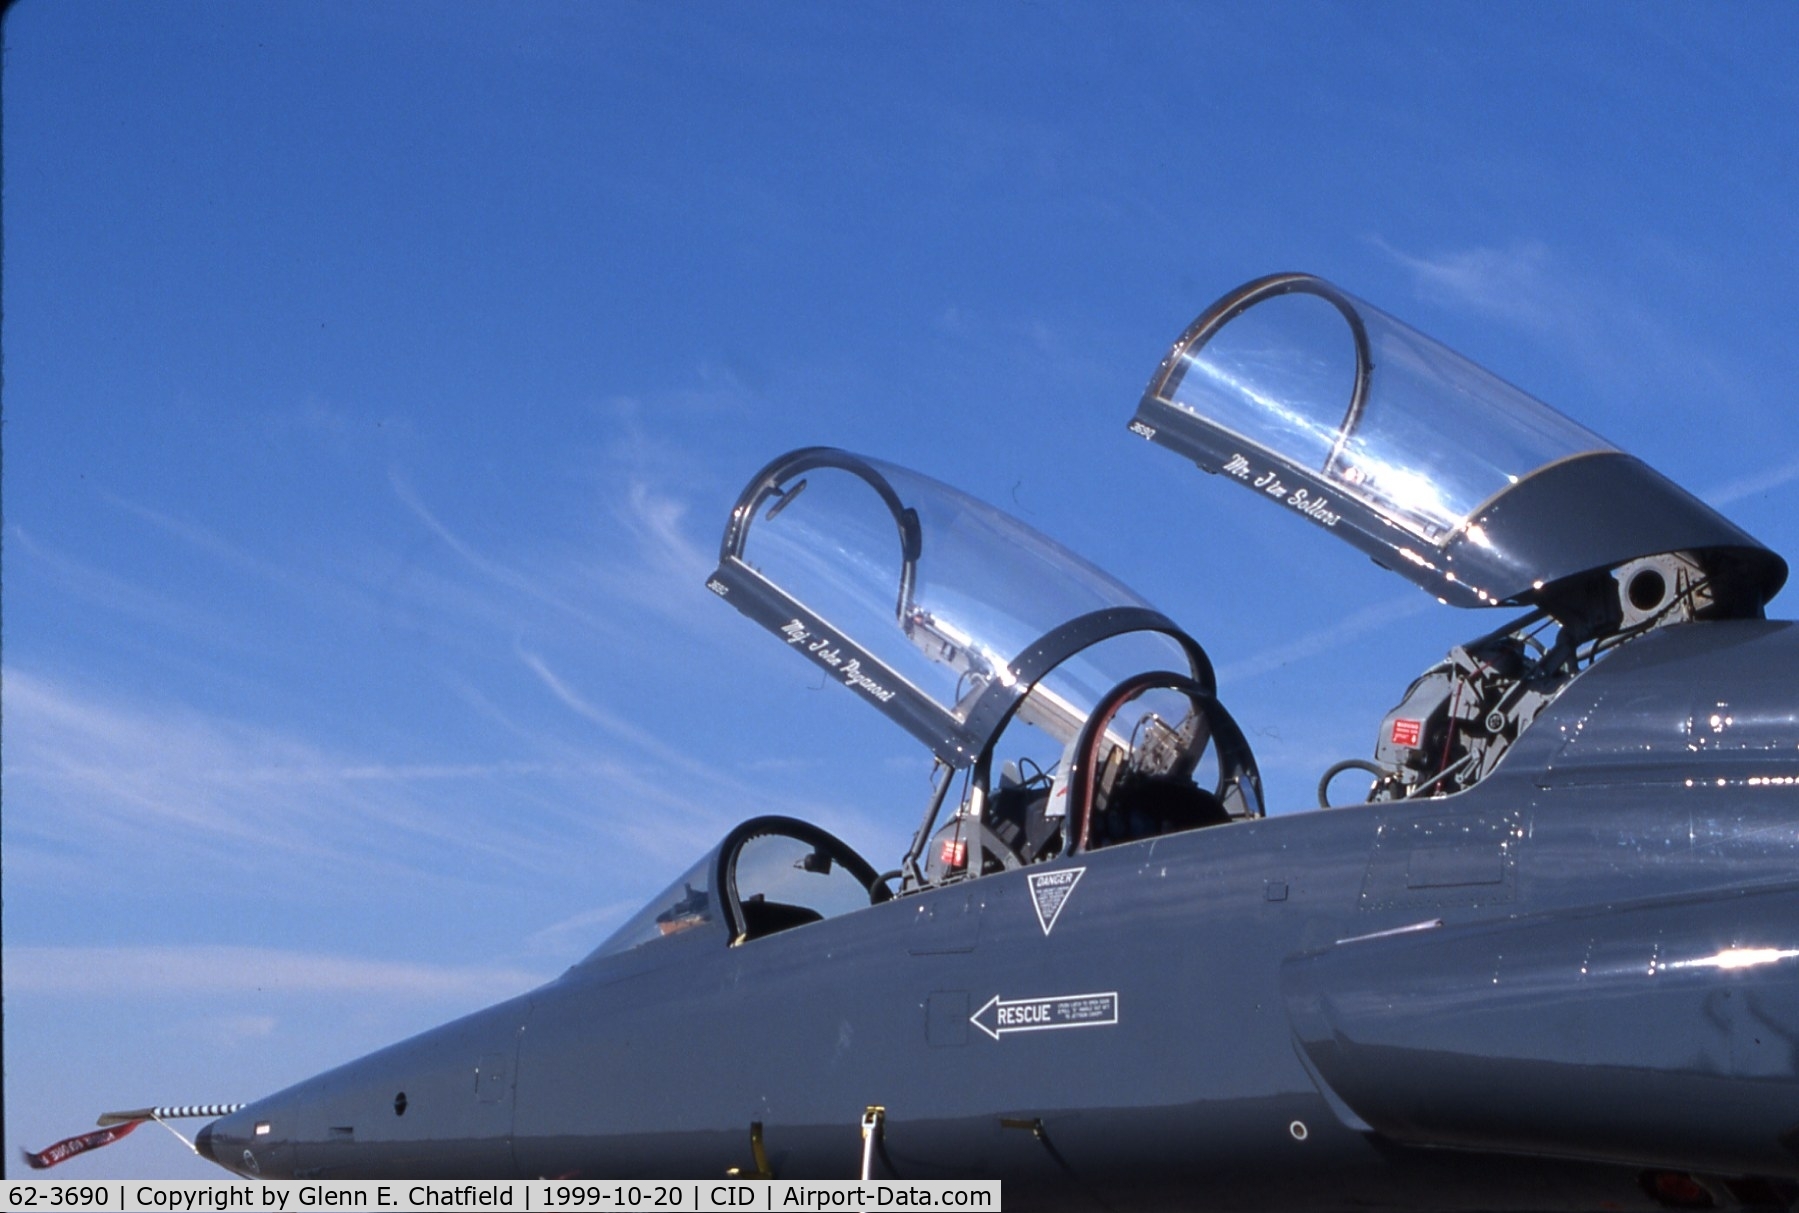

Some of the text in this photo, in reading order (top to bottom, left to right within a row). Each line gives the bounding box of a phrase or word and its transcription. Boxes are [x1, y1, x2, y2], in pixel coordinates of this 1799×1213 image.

[1223, 453, 1250, 480] Mr.
[1254, 471, 1287, 498] Jim
[808, 639, 842, 666] John
[1036, 872, 1073, 888] DANGER
[998, 1004, 1051, 1025] RESCUE
